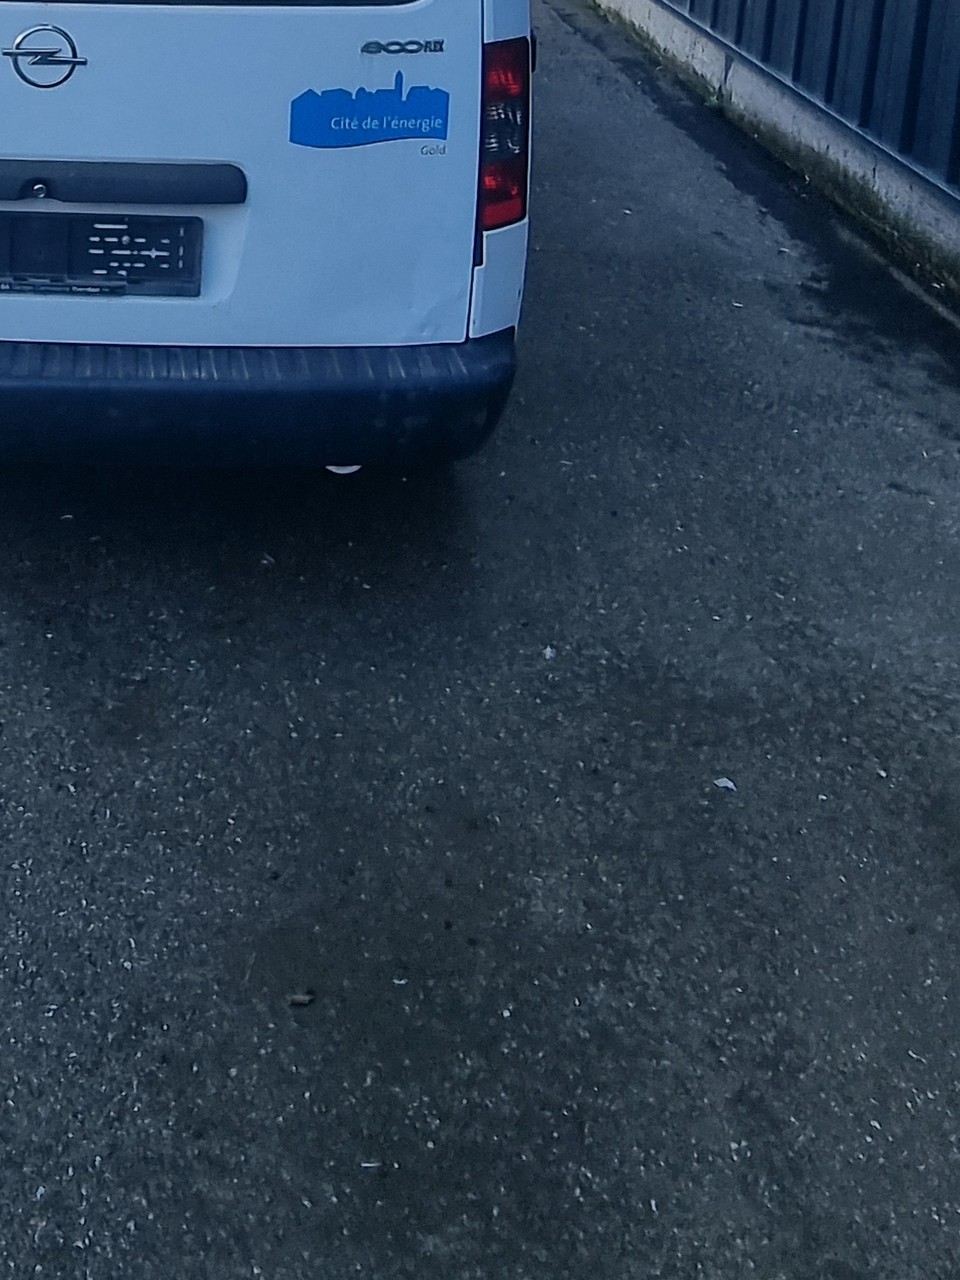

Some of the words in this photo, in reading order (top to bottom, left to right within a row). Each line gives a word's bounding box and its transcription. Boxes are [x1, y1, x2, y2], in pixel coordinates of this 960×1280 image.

[330, 117, 358, 130] Cité
[361, 116, 379, 130] de
[383, 116, 443, 132] l'énergie
[420, 145, 446, 156] Gold
